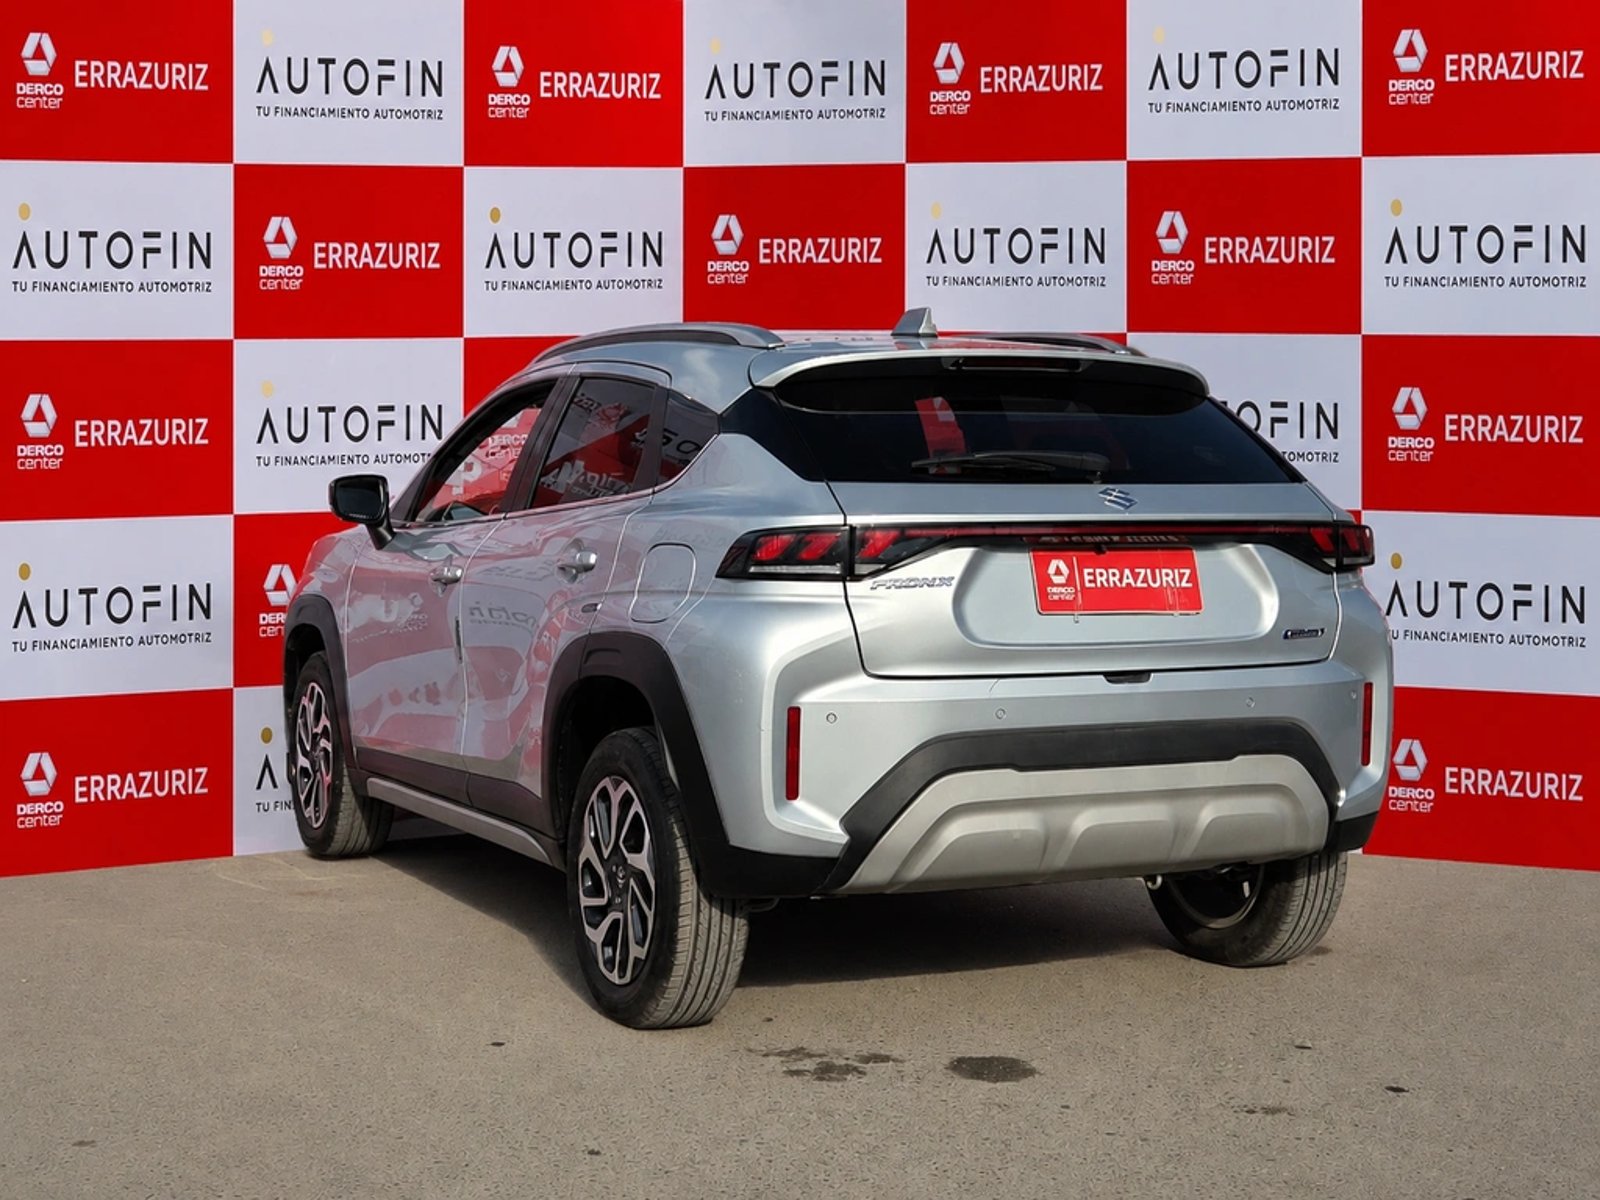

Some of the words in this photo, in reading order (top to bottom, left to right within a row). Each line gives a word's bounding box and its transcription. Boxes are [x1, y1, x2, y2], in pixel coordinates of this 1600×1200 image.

[1149, 48, 1338, 90] AUTOFIN
[1446, 51, 1584, 81] ERRAZURIZ
[75, 60, 208, 90] ERRAZURIZ
[257, 57, 442, 97] AUTOFIN
[705, 60, 885, 99] AUTOFIN
[981, 64, 1103, 93] ERRAZURIZ
[17, 83, 63, 95] DERCO
[540, 72, 661, 98] ERRAZURIZ
[1389, 79, 1435, 91] DERCO
[17, 97, 63, 108] center
[488, 94, 530, 105] DERCO
[930, 90, 971, 102] DERCO
[1389, 93, 1435, 105] center
[488, 107, 530, 118] center
[930, 103, 971, 114] center
[1149, 103, 1161, 113] TU
[1166, 101, 1261, 112] FINANCIAMIENTO
[1266, 99, 1339, 110] AUTOMOTRIZ
[256, 106, 269, 116] TU
[275, 107, 369, 118] FINANCIAMIENTO
[374, 109, 442, 120] AUTOMOTRIZ
[705, 112, 717, 121] TU
[722, 110, 813, 120] FINANCIAMIENTO
[817, 108, 885, 119] AUTOMOTRIZ
[13, 231, 211, 269] AUTOFIN
[486, 232, 662, 268] AUTOFIN
[759, 238, 882, 263] ERRAZURIZ
[927, 228, 1105, 264] AUTOFIN
[1205, 236, 1335, 263] ERRAZURIZ
[1385, 225, 1585, 264] AUTOFIN
[314, 242, 440, 269] ERRAZURIZ
[259, 266, 303, 277] DERCO
[708, 261, 749, 272] DERCO
[1152, 260, 1194, 271] DERCO
[259, 278, 303, 290] center
[485, 281, 497, 291] TU
[502, 280, 592, 290] FINANCIAMIENTO
[597, 279, 662, 289] AUTOMOTRIZ
[708, 273, 749, 284] center
[927, 276, 939, 286] TU
[944, 276, 1033, 286] FINANCIAMIENTO
[1037, 276, 1105, 287] AUTOMOTRIZ
[1152, 273, 1194, 284] center
[1385, 277, 1398, 287] TU
[1404, 276, 1504, 287] FINANCIAMIENTO
[1509, 276, 1586, 287] AUTOMOTRIZ
[13, 281, 27, 292] TU
[33, 281, 133, 292] FINANCIAMIENTO
[139, 282, 211, 292] AUTOMOTRIZ
[257, 405, 443, 445] AUTOFIN
[1236, 400, 1338, 440] OFIN
[75, 418, 208, 447] ERRAZURIZ
[1445, 415, 1583, 443] ERRAZURIZ
[1388, 437, 1434, 448] DERCO
[17, 444, 64, 456] DERCO
[1388, 450, 1434, 461] center
[17, 457, 64, 469] center
[257, 456, 270, 466] TU
[275, 455, 369, 465] FINANCIAMIENTO
[374, 453, 431, 464] AUTOMOT
[1282, 451, 1339, 463] TOMOTRIZ
[870, 576, 955, 590] FRONX
[1083, 568, 1193, 588] ERRAZURIZ
[13, 583, 211, 628] AUTOFIN
[1385, 580, 1585, 624] AUTOFIN
[259, 612, 287, 625] DER
[259, 625, 285, 637] cen
[13, 642, 27, 652] TU
[33, 636, 133, 651] FINANCIAMIENTO
[138, 632, 211, 645] AUTOMOTRIZ
[1404, 630, 1504, 644] FINANCIAMIENTO
[1509, 635, 1585, 647] AUTOMOTRIZ
[75, 768, 208, 803] ERRAZURIZ
[1446, 767, 1583, 800] ERRAZURIZ
[1389, 786, 1434, 799] DERCO
[17, 801, 64, 814] DERCO
[256, 802, 269, 812] TU
[1389, 800, 1434, 812] center
[17, 813, 64, 828] center
